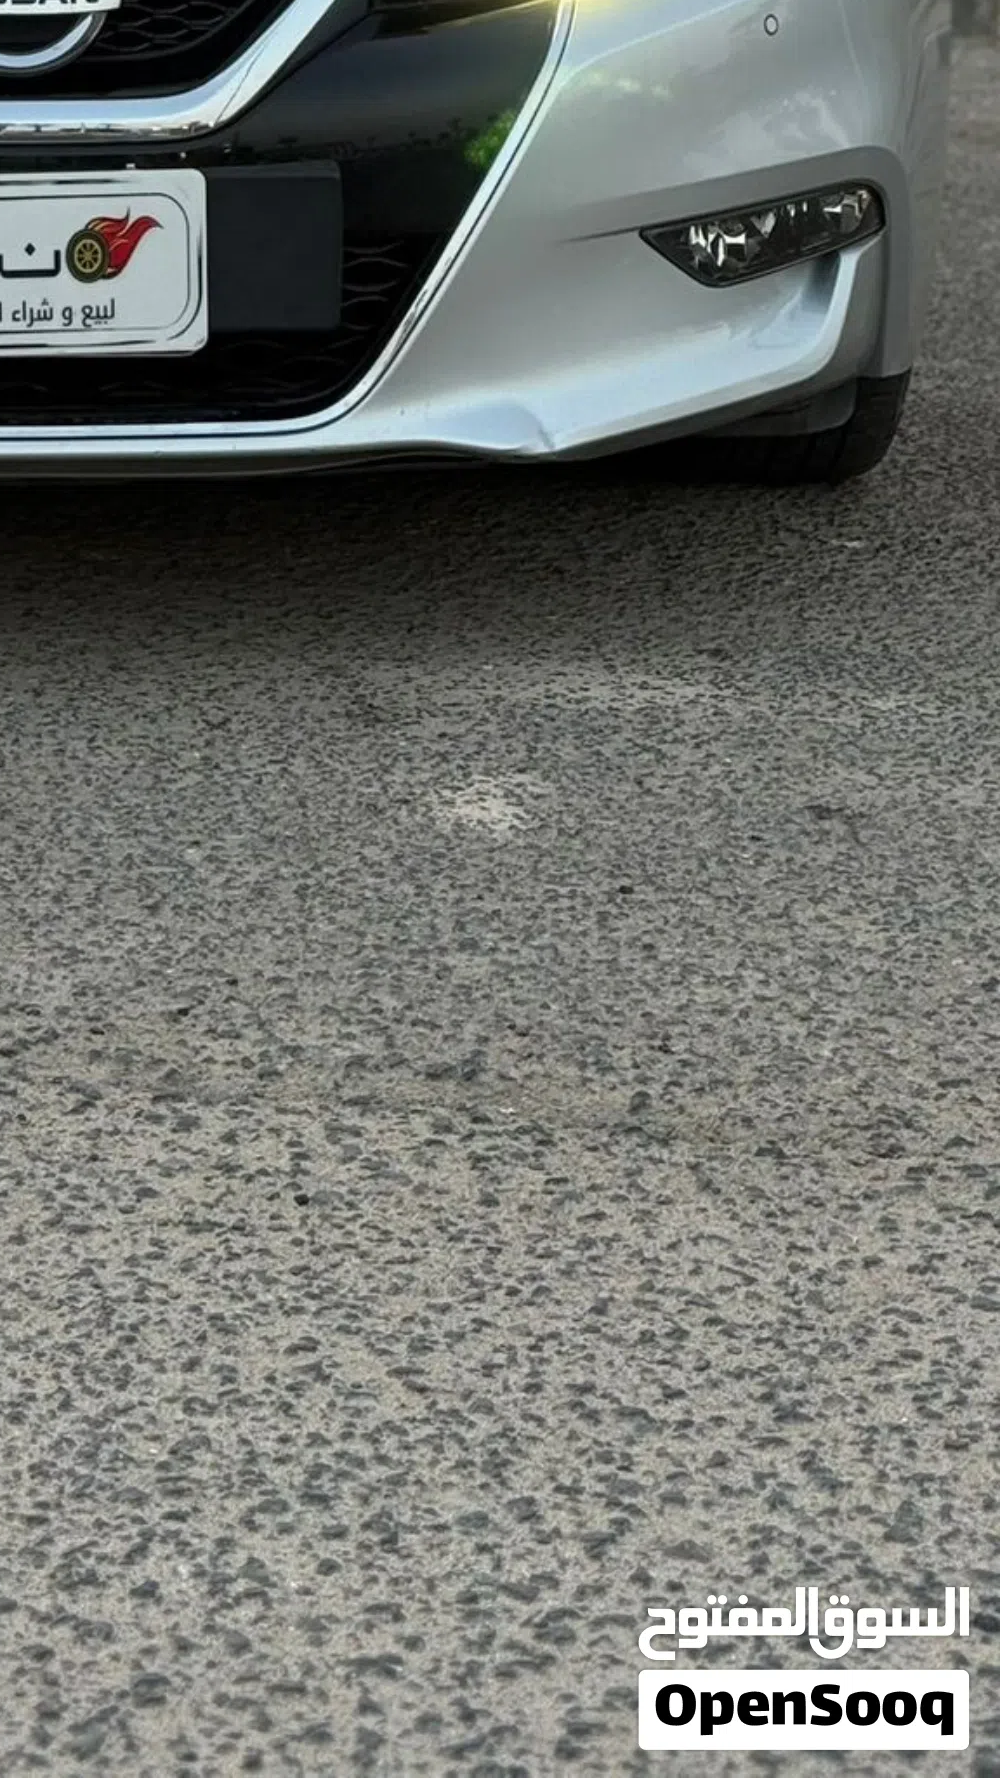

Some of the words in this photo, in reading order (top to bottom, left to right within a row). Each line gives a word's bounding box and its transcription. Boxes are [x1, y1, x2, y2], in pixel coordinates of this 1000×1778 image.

[11, 298, 53, 327] شراء
[61, 305, 74, 327] و
[81, 297, 116, 328] لبيع
